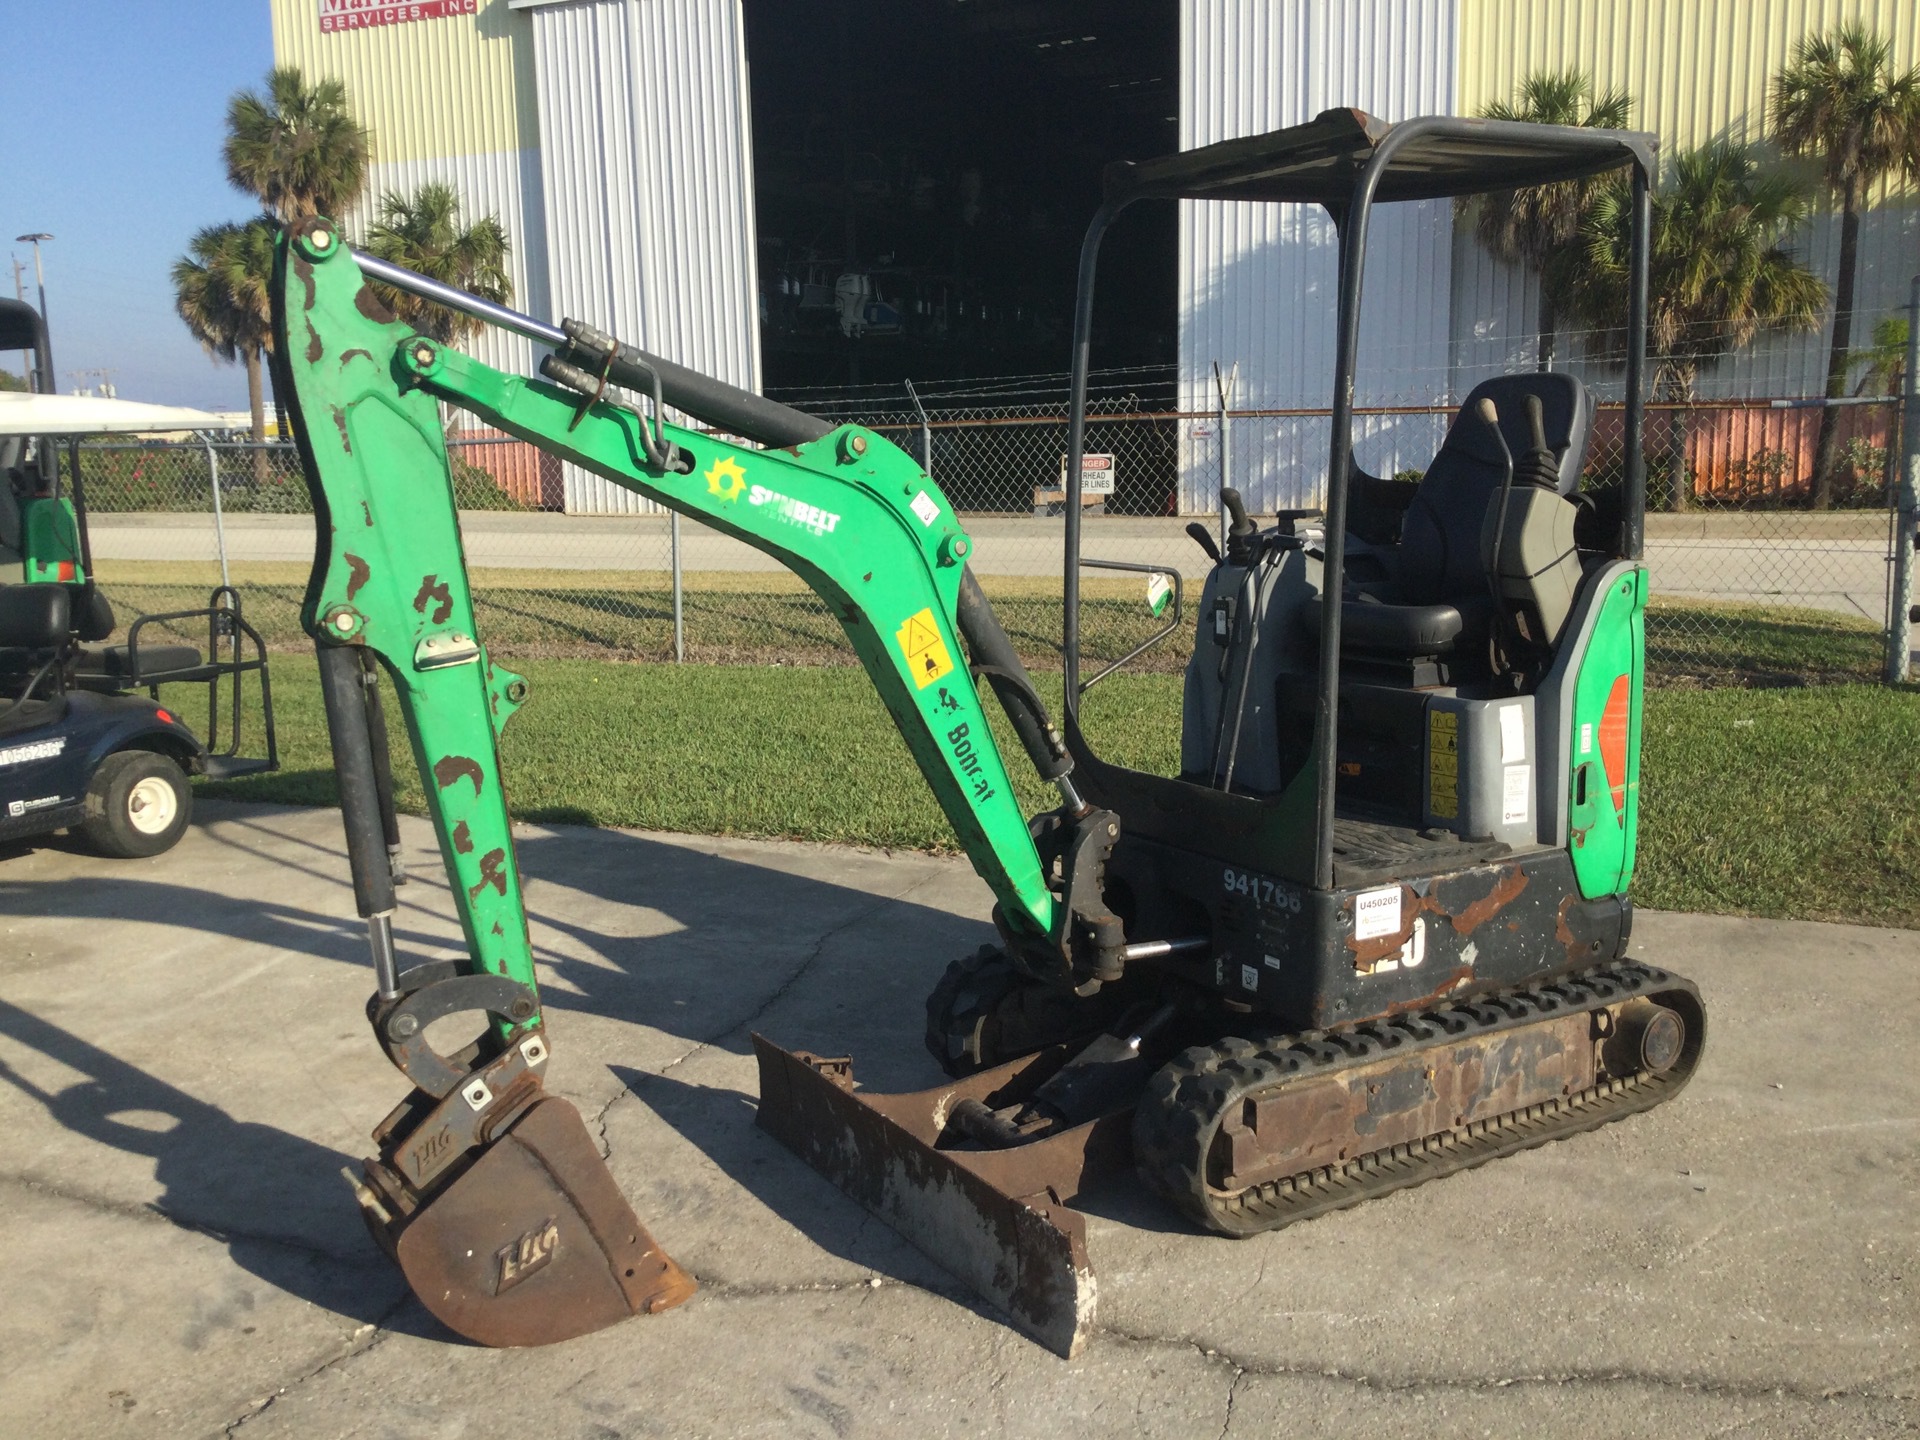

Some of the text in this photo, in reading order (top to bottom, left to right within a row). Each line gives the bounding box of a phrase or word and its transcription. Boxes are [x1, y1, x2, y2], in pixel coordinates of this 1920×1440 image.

[323, 0, 474, 29] SERVICES, INC
[1091, 480, 1110, 488] LINES
[749, 484, 840, 533] SUNBELT
[1360, 896, 1398, 910] U450205
